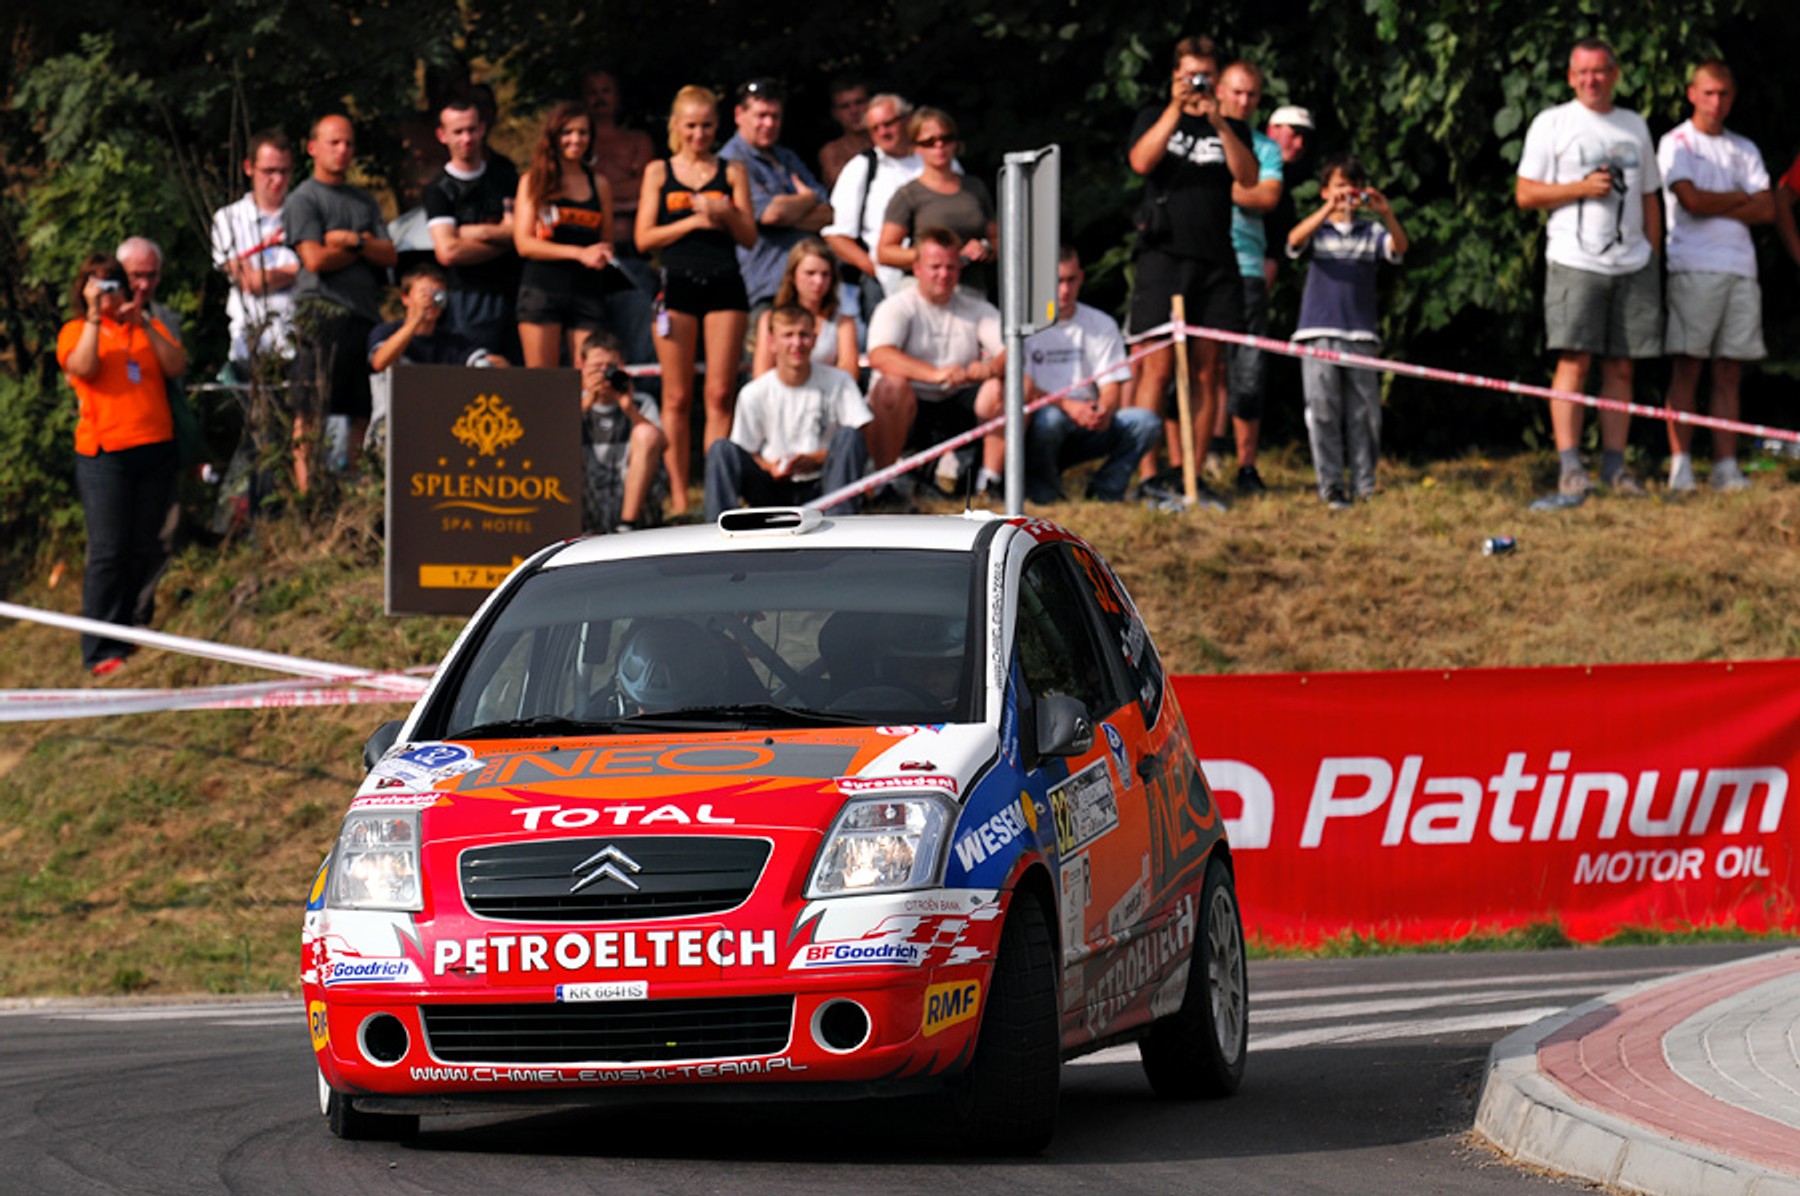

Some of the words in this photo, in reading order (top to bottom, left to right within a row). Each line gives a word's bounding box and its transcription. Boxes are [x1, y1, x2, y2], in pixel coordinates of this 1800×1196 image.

[410, 472, 571, 503] SPLENDOR
[442, 518, 473, 531] SPA
[482, 519, 533, 533] HOTEL
[453, 570, 478, 585] 1,7
[495, 745, 775, 783] NEO
[1299, 751, 1789, 848] Platinum
[511, 804, 736, 831] TOTAL
[955, 799, 1027, 873] WESEM
[1574, 848, 1703, 884] MOTOR
[1715, 845, 1770, 878] OIL
[433, 929, 776, 975] PETROELTECH
[806, 944, 919, 961] BFGoodrich
[570, 986, 591, 999] KR
[926, 984, 976, 1026] RMF
[410, 1057, 808, 1082] WWW.CHMIELEWSKI-TEAM.PL
